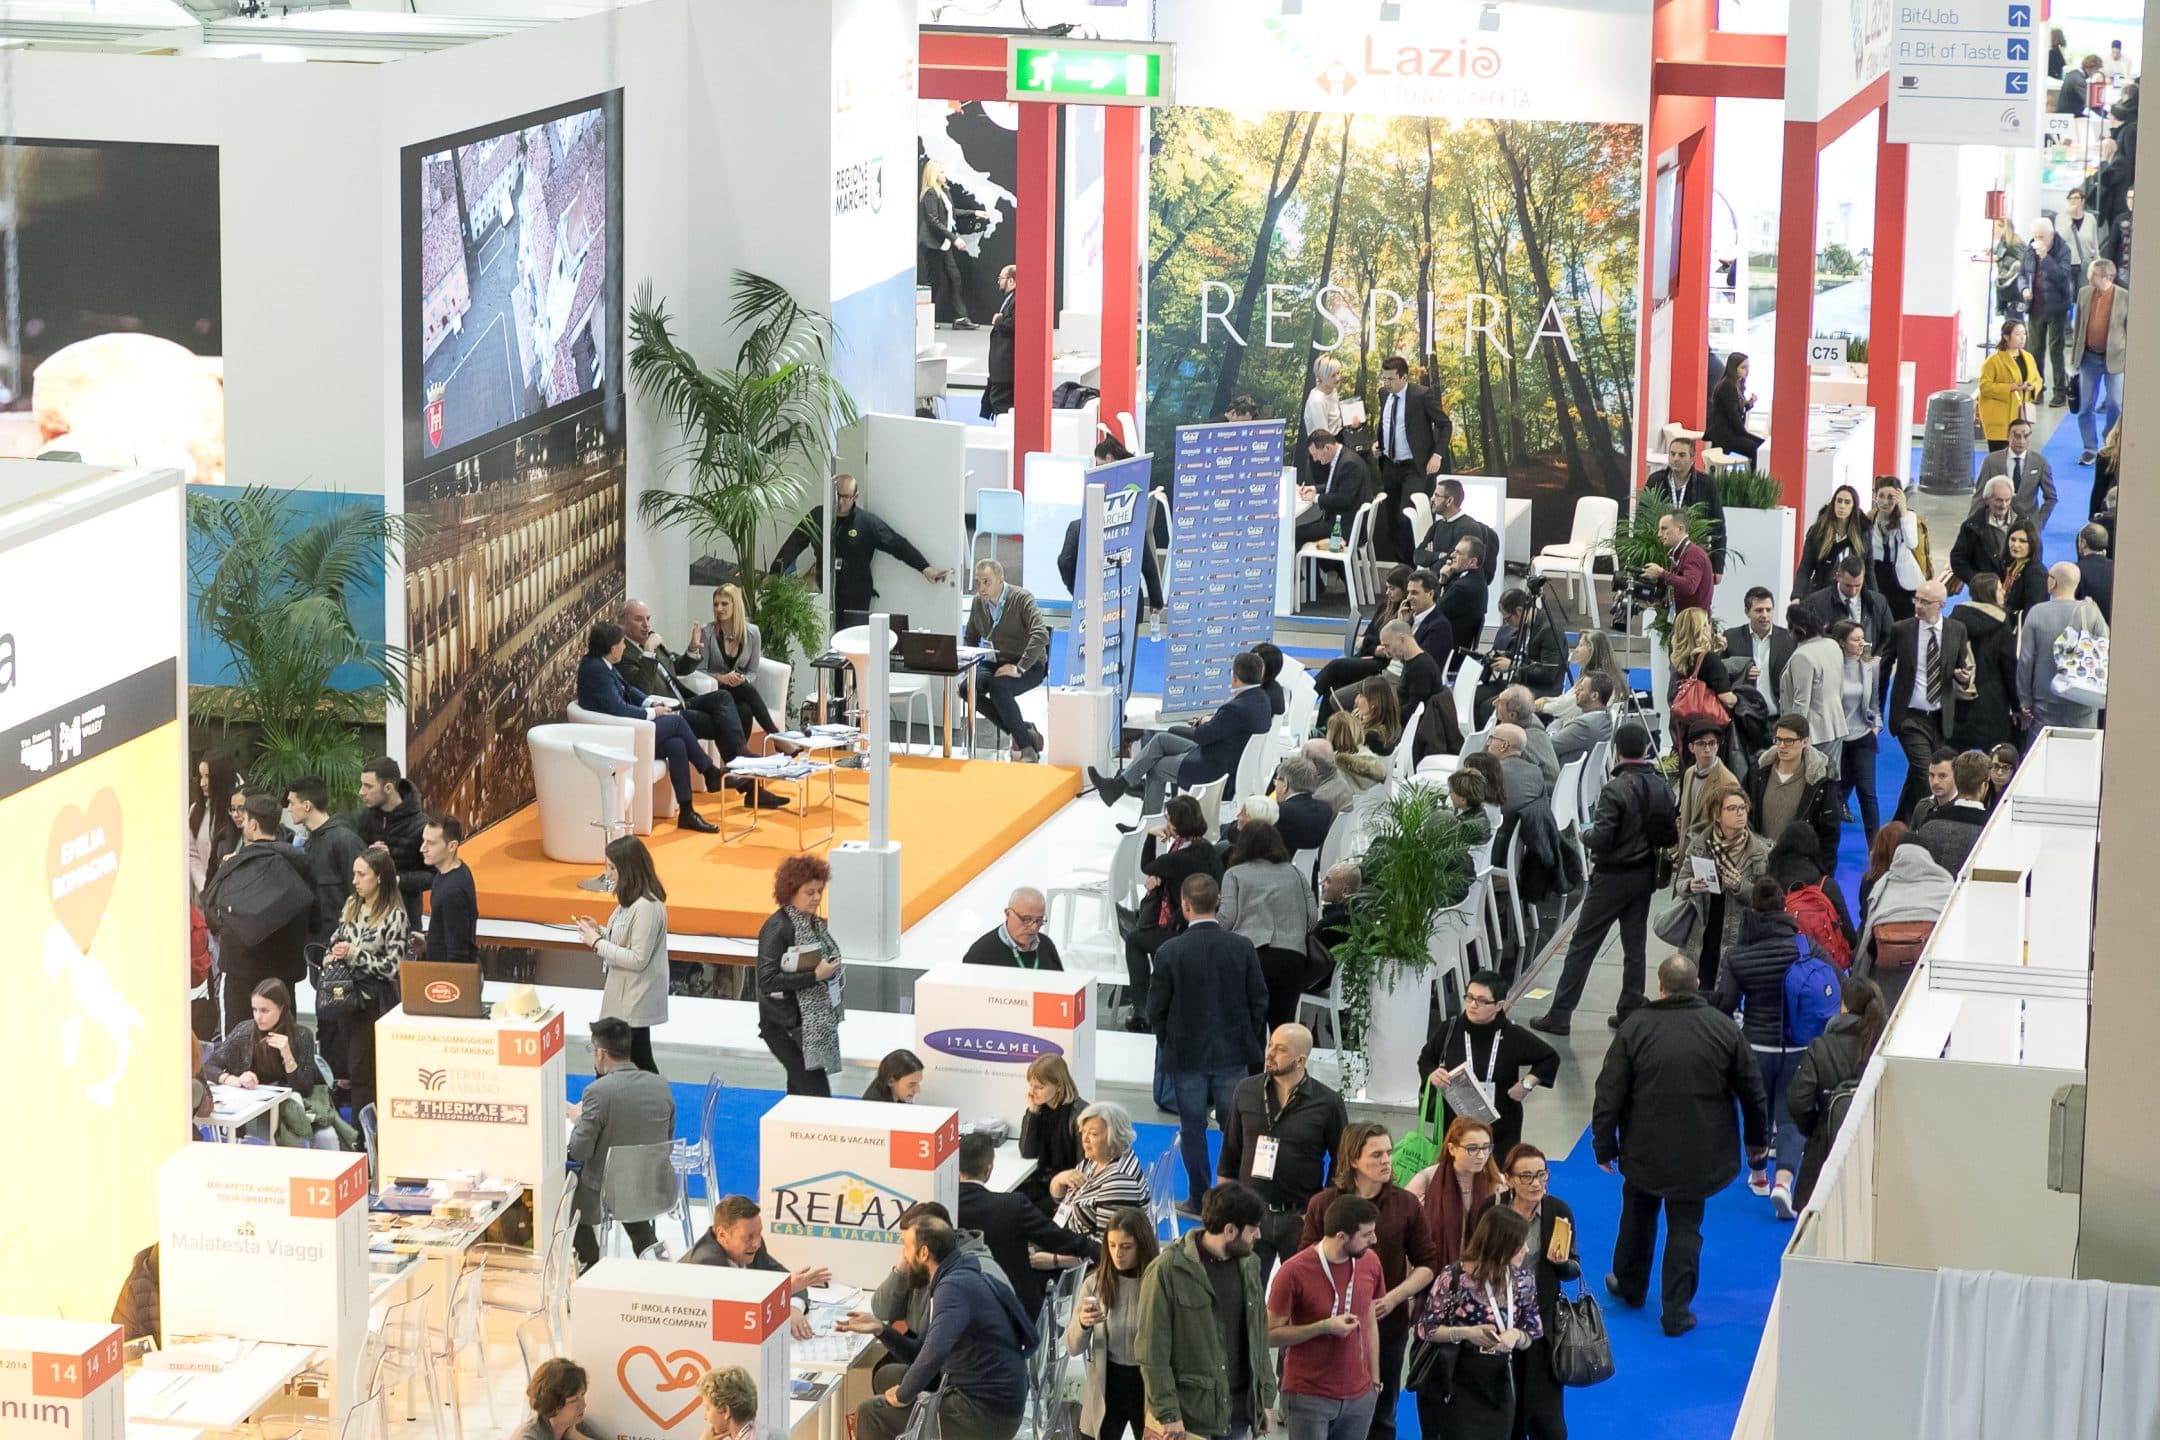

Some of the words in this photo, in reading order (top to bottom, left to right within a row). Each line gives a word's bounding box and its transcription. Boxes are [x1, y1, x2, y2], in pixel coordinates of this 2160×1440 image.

[1901, 7, 1959, 25] Bit4Job
[1363, 34, 1502, 79] Lazio
[1900, 42, 1911, 57] A
[1915, 42, 1936, 58] Bit
[1940, 43, 1956, 58] of
[1961, 43, 2001, 60] Taste
[2049, 119, 2069, 129] C79
[836, 162, 868, 190] REGIONE
[835, 186, 868, 216] MARCHE
[1200, 281, 1578, 362] RESPIRA
[1812, 346, 1839, 360] C75
[988, 997, 1029, 1007] ITALCAMEL
[1060, 1001, 1068, 1017] 1
[1078, 997, 1082, 1011] 1
[418, 1034, 427, 1042] DI
[543, 1032, 550, 1050] 10
[555, 1023, 561, 1039] 9
[947, 1037, 1040, 1054] ITALCAMEL
[514, 1038, 537, 1055] 10
[420, 1101, 499, 1116] THERMAE
[432, 1113, 498, 1122] SALSOMAGGIORE
[790, 1131, 816, 1141] RELAX
[816, 1133, 838, 1142] CASE
[840, 1135, 846, 1143] &
[847, 1136, 886, 1146] VACANZE
[938, 1134, 943, 1152] 3
[950, 1124, 955, 1141] 2
[918, 1140, 930, 1158] 3
[338, 1179, 349, 1200] 12
[353, 1167, 363, 1188] 11
[306, 1187, 332, 1205] 12
[774, 1189, 917, 1231] RELAX
[773, 1224, 814, 1237] CASE
[822, 1226, 832, 1238] &
[840, 1228, 902, 1244] VACANZ
[171, 1232, 260, 1255] Malatesta
[267, 1239, 324, 1262] Viaggi
[631, 1303, 640, 1311] IF
[642, 1304, 670, 1313] IMOLA
[672, 1306, 708, 1317] FAENZA
[766, 1304, 772, 1324] 5
[780, 1289, 786, 1308] 4
[620, 1314, 661, 1325] TOURISM
[662, 1317, 708, 1329] COMPANY
[744, 1311, 757, 1330] 5
[5, 1361, 27, 1370] 2014
[86, 1355, 99, 1378] 14
[105, 1341, 118, 1364] 13
[51, 1363, 78, 1383] 14
